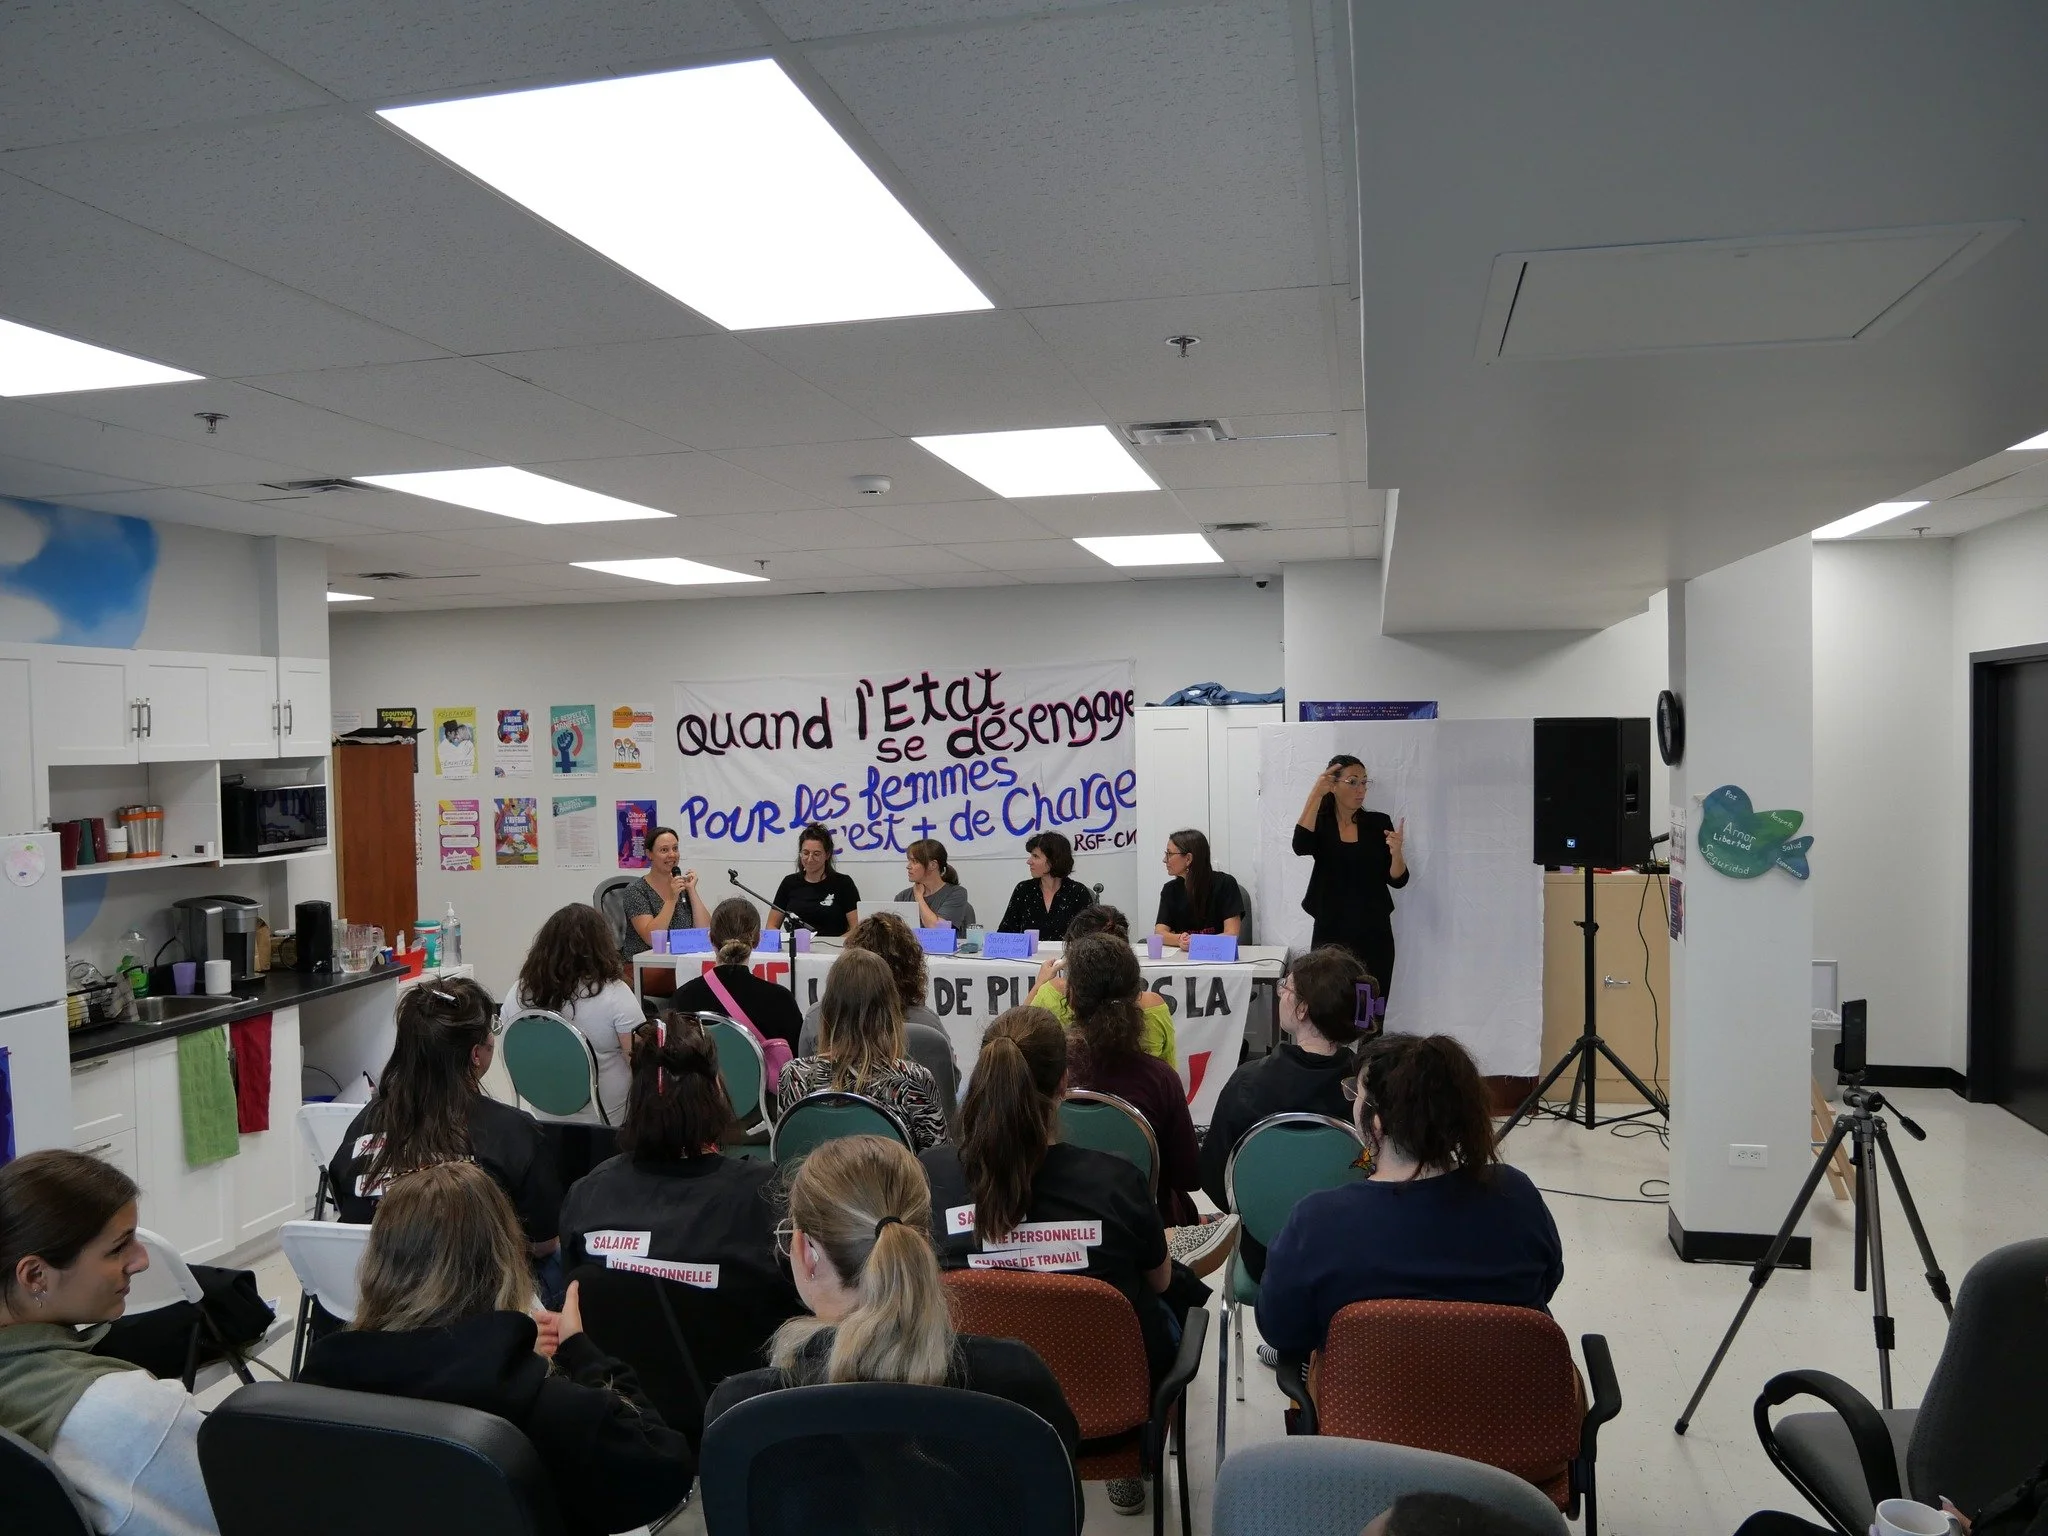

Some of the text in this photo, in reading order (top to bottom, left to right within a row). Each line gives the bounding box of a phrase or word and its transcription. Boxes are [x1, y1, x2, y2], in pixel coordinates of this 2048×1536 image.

[676, 668, 1005, 756] Quand l'Etat
[876, 689, 1135, 763] se désengage
[680, 756, 1018, 843] POUR Des femmes
[950, 800, 996, 842] de
[1002, 769, 1137, 836] Charge
[1701, 843, 1750, 875] Seguridad
[1713, 832, 1752, 851] Libertad
[1782, 842, 1802, 852] Salud
[933, 976, 973, 1017] DE
[1185, 976, 1233, 1019] LA
[593, 1236, 641, 1251] SALAIRE
[1011, 1227, 1096, 1244] PERSONNELLE
[1020, 1256, 1036, 1268] DE
[1036, 1251, 1083, 1266] TRAVAIL
